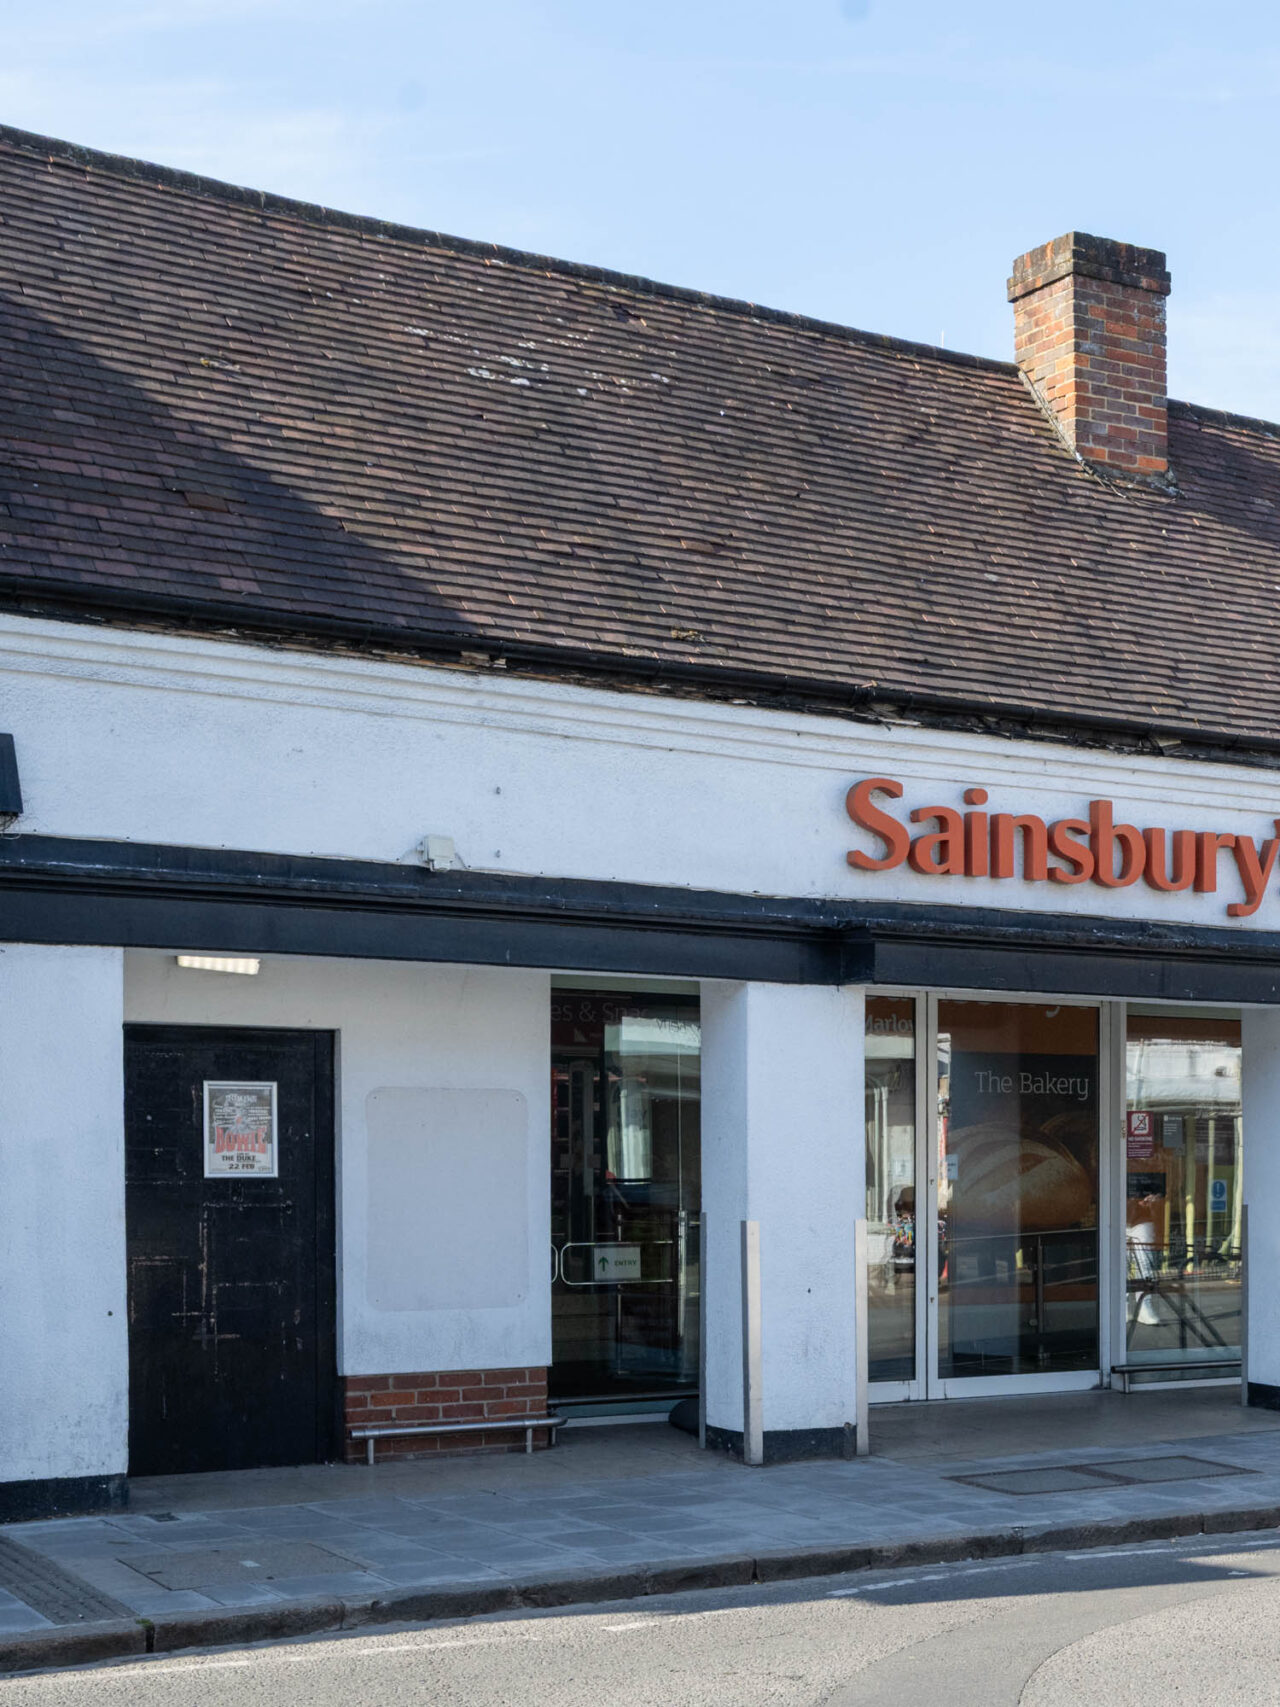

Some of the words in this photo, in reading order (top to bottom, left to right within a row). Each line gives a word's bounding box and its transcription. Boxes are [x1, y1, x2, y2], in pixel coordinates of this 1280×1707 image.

[974, 1071, 1012, 1094] The
[1019, 1072, 1089, 1100] Bakery
[215, 1126, 267, 1154] BOWIE
